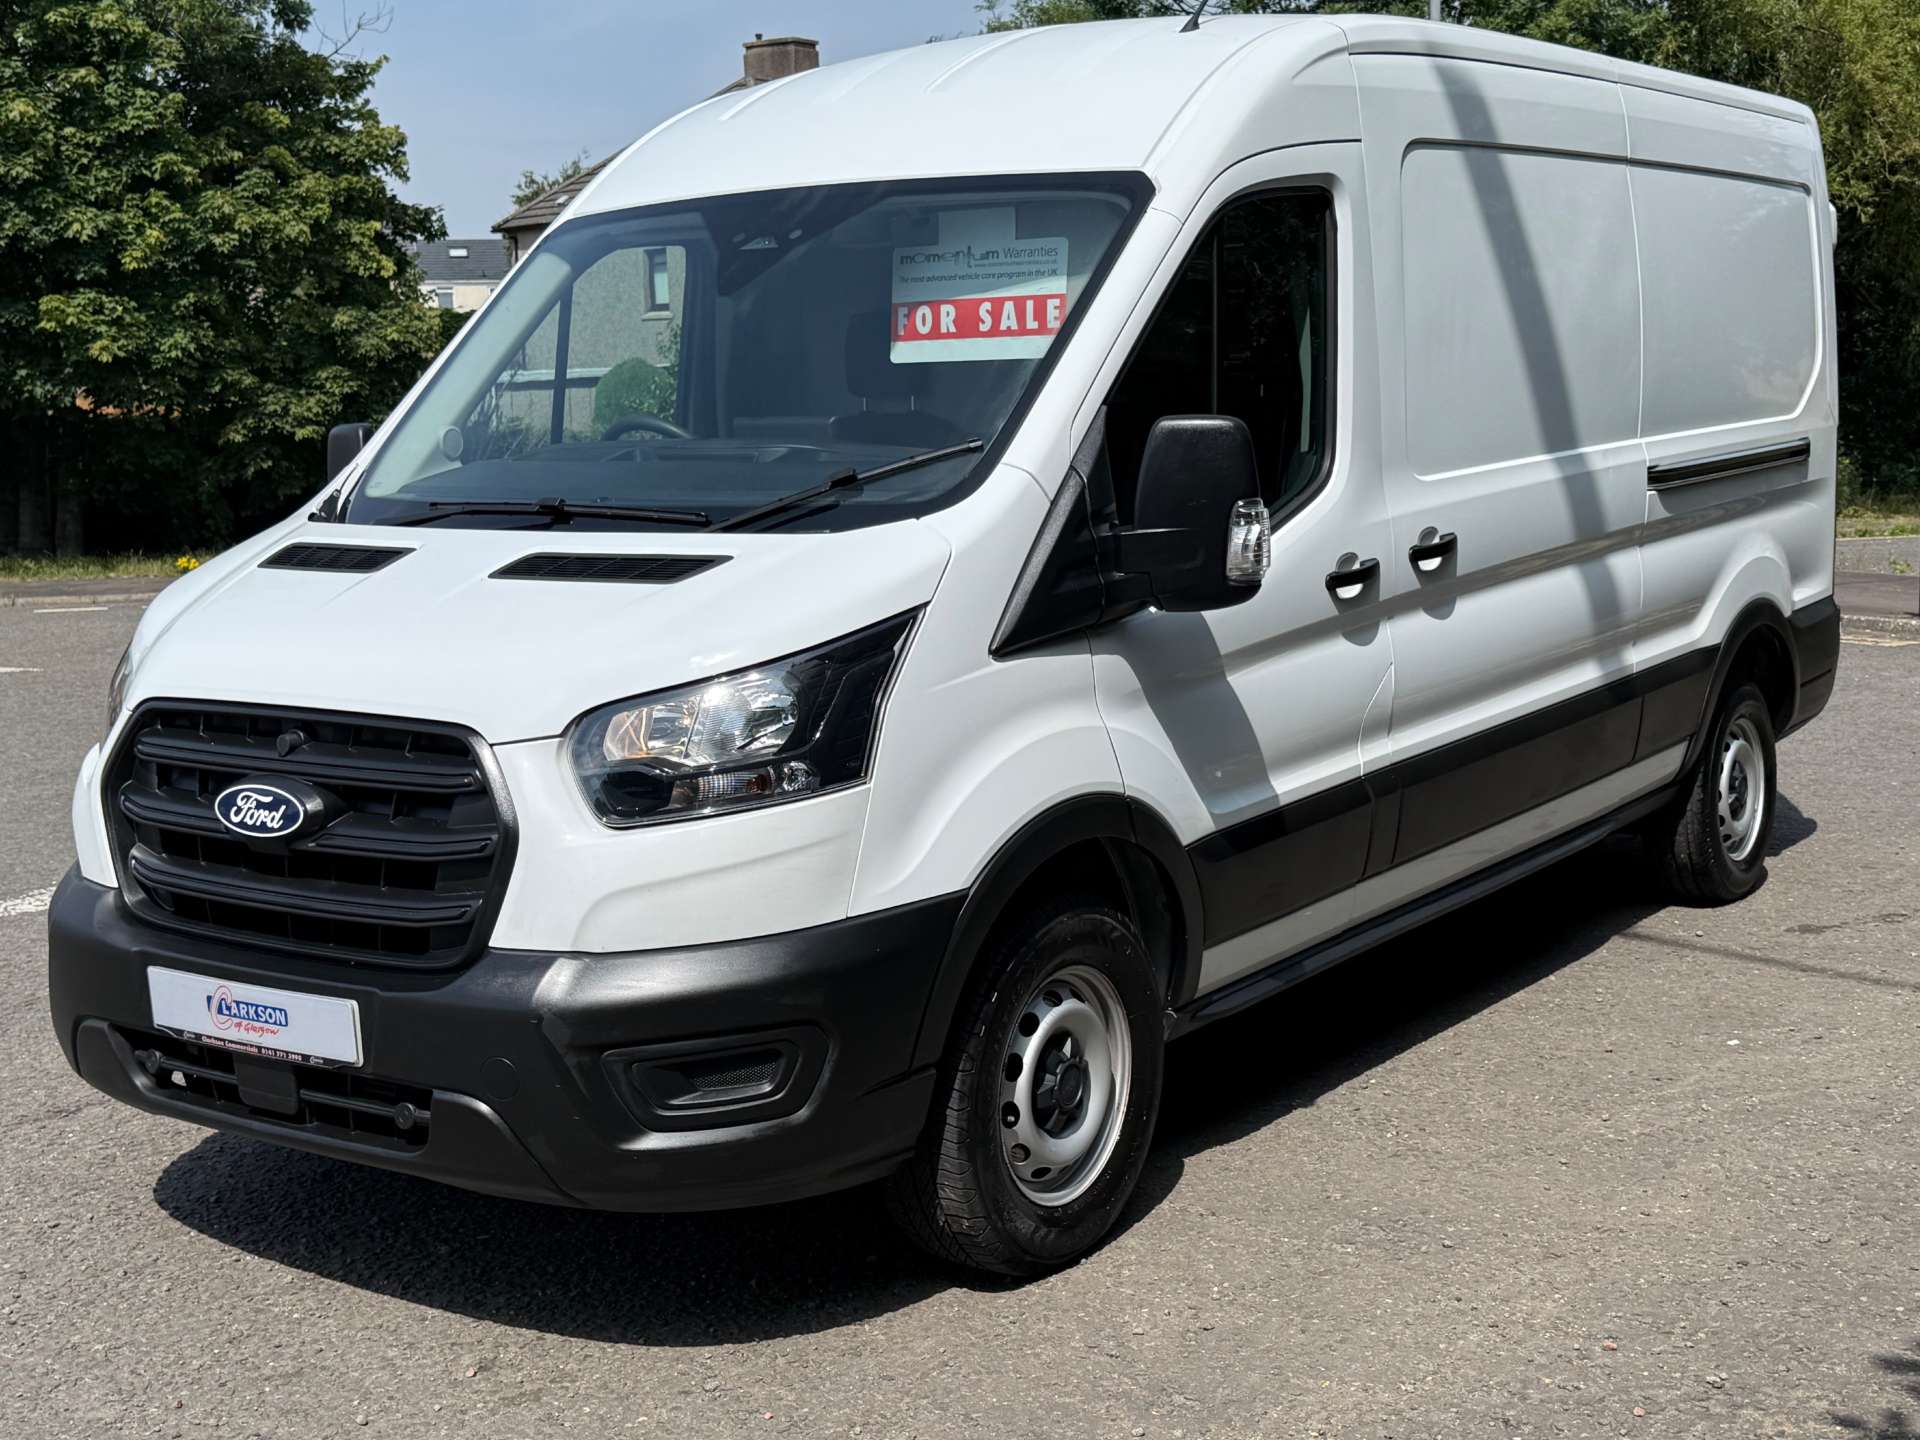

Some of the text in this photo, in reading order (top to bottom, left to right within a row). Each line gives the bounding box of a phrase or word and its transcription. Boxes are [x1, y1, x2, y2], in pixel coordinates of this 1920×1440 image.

[1003, 244, 1058, 259] Warranties
[958, 272, 980, 281] vehicle
[997, 271, 1026, 281] program
[1035, 269, 1047, 277] the
[897, 299, 1061, 336] FOR SALE
[230, 791, 287, 829] Ford
[211, 985, 287, 1030] CLARKSON
[234, 1022, 280, 1038] of Glasgow
[225, 1040, 258, 1054] Commercials
